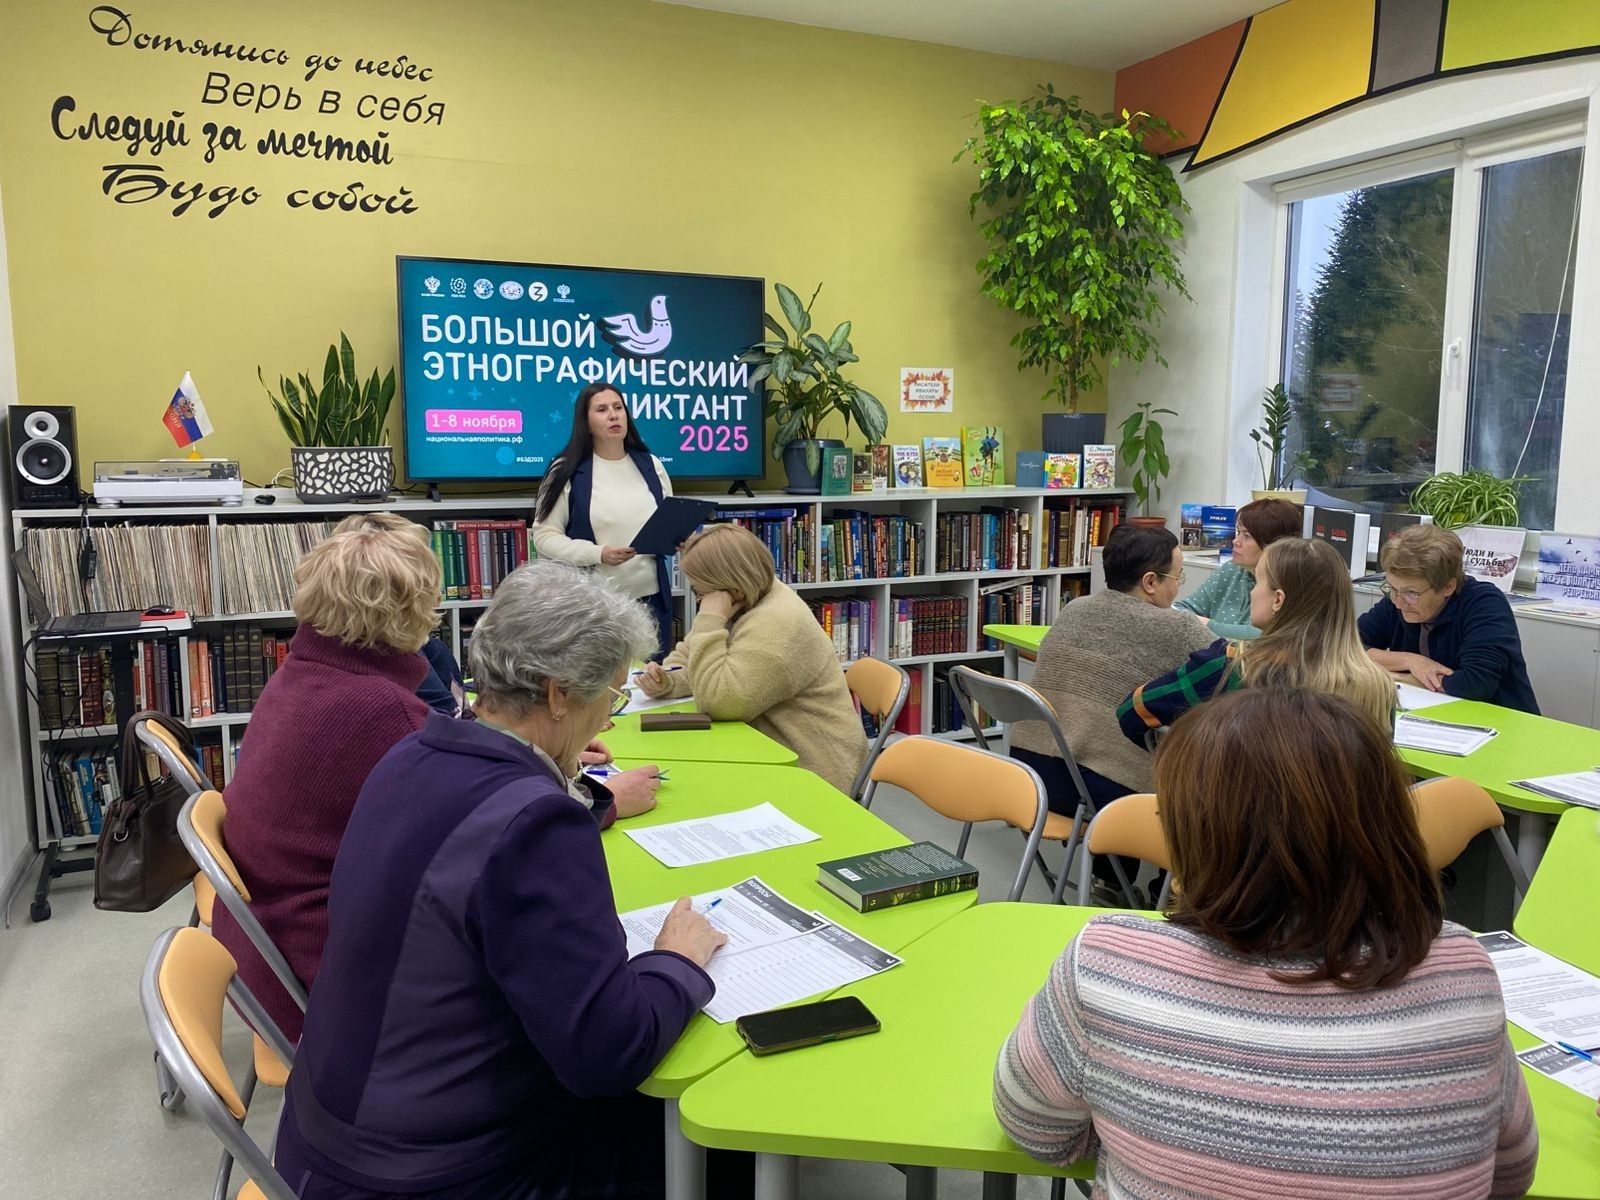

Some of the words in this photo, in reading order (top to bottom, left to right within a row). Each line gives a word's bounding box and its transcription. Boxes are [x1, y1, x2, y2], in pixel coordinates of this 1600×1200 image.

[88, 4, 290, 66] Дотянись
[303, 54, 343, 82] до
[354, 54, 434, 82] небес
[202, 71, 302, 114] Верь
[319, 90, 342, 115] в
[356, 94, 446, 126] себя
[51, 95, 191, 157] Следуй
[202, 122, 247, 164] за
[256, 130, 394, 166] мечтой
[101, 163, 262, 219] Будь
[286, 181, 420, 215] собой
[421, 313, 596, 349] БОЛЬШОЙ
[422, 351, 749, 389] ЭТНОГРАФИЧЕСКИЙ
[462, 412, 516, 430] ноября
[623, 392, 748, 421] ИКТАНТ
[680, 425, 748, 453] 2025
[1470, 557, 1506, 566] судьбы
[1562, 587, 1600, 600] РЕПРЕССИ
